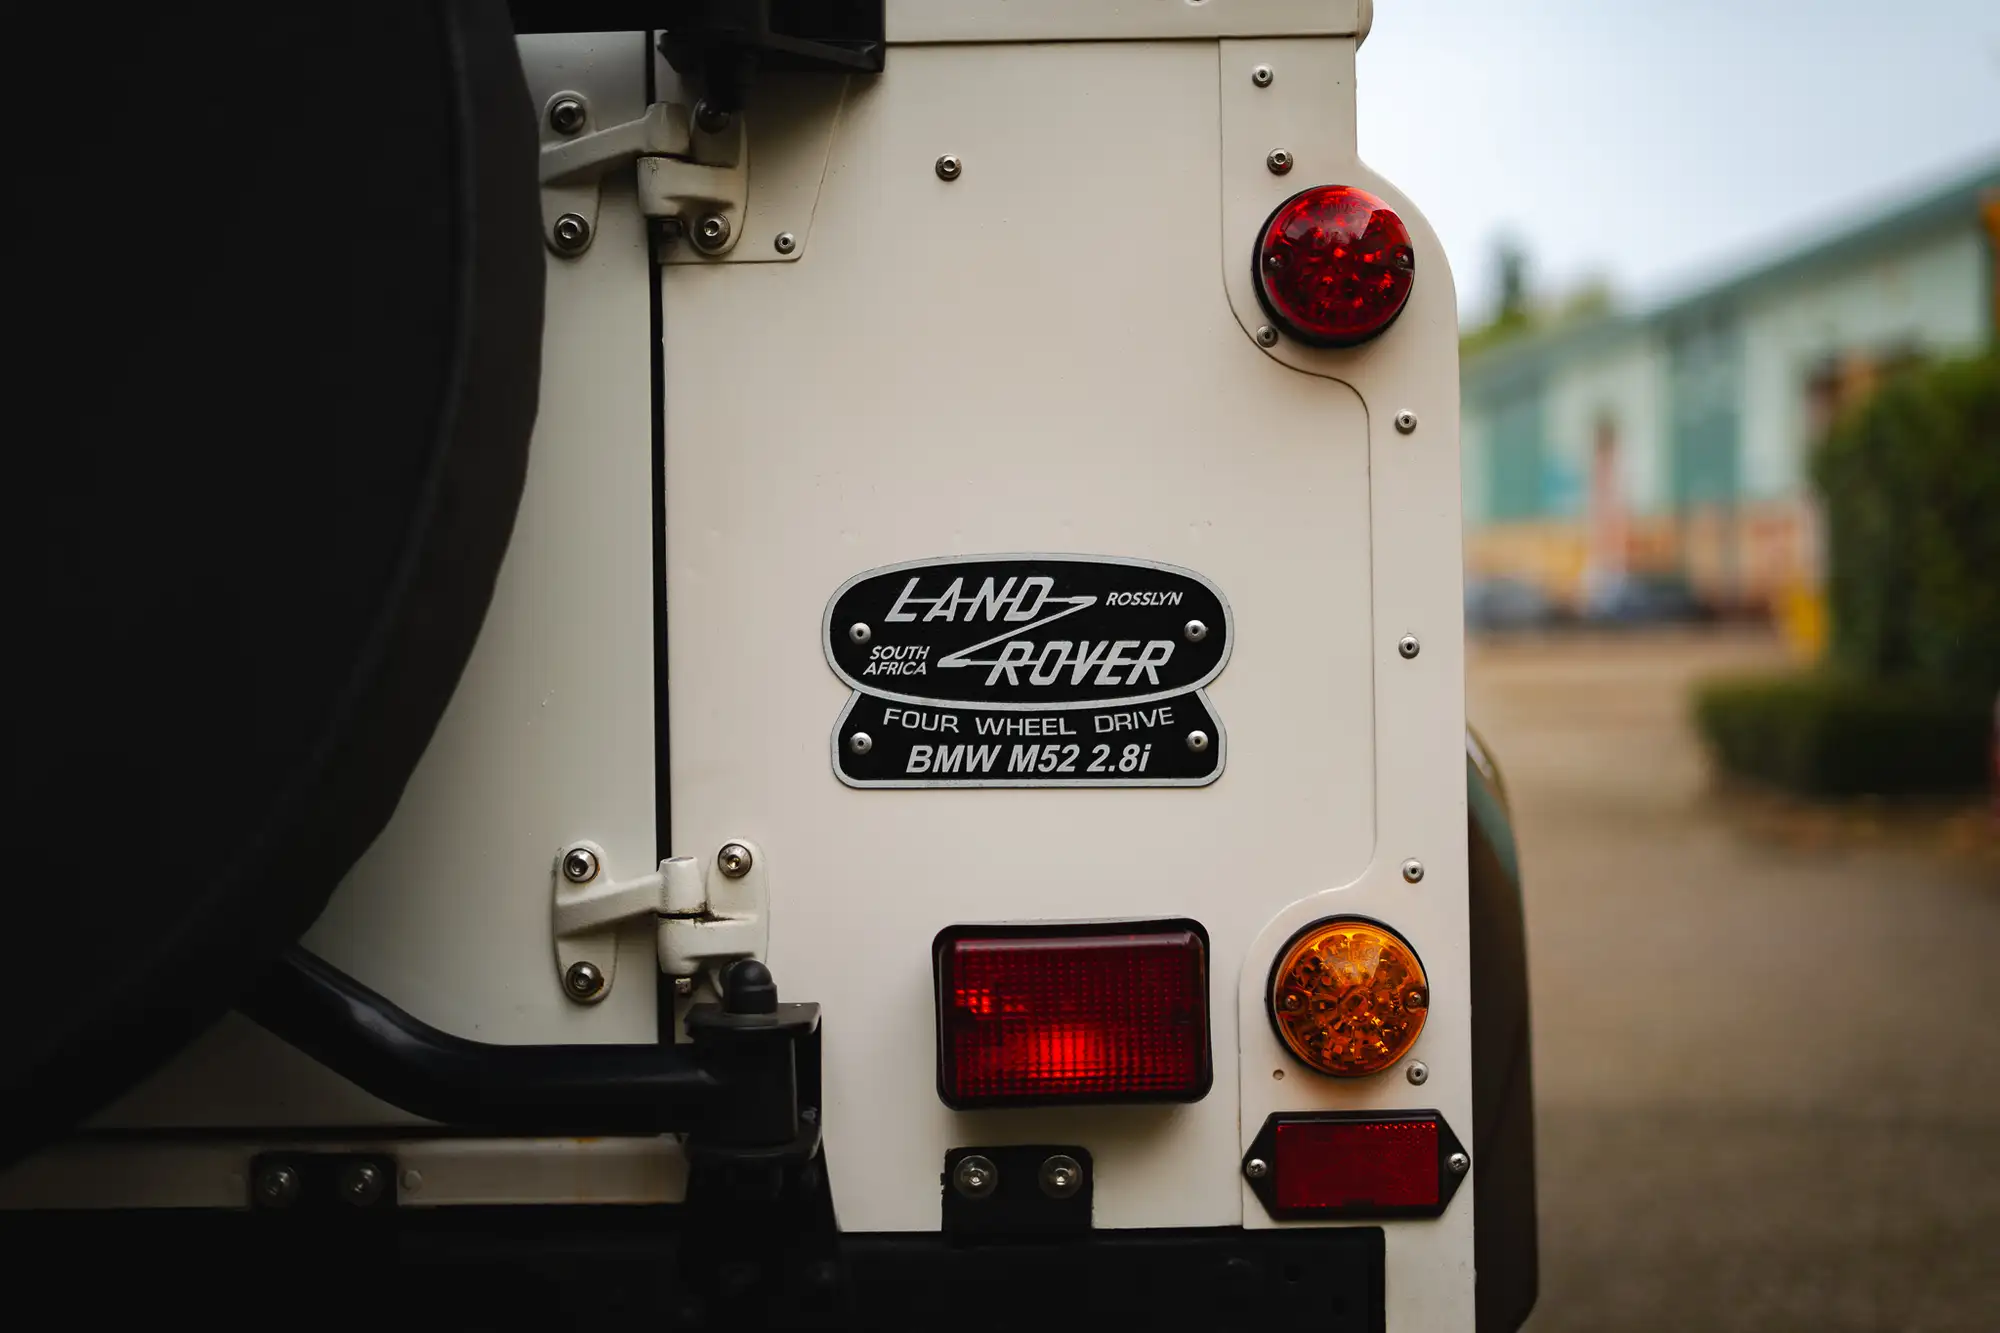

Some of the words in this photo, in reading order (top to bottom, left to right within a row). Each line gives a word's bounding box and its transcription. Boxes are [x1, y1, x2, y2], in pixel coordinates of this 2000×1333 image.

[884, 576, 1055, 622] LAND
[1106, 592, 1183, 606] ROSSLYN
[870, 645, 930, 660] SOUTH
[985, 640, 1176, 686] ROVER
[863, 661, 927, 676] AFRICA
[884, 708, 959, 733] FOUR
[975, 717, 1077, 736] WHEEL
[1095, 706, 1175, 733] DRIVE
[906, 745, 1001, 773] BMW
[1007, 744, 1078, 773] M52
[1087, 743, 1152, 773] 2.8i
